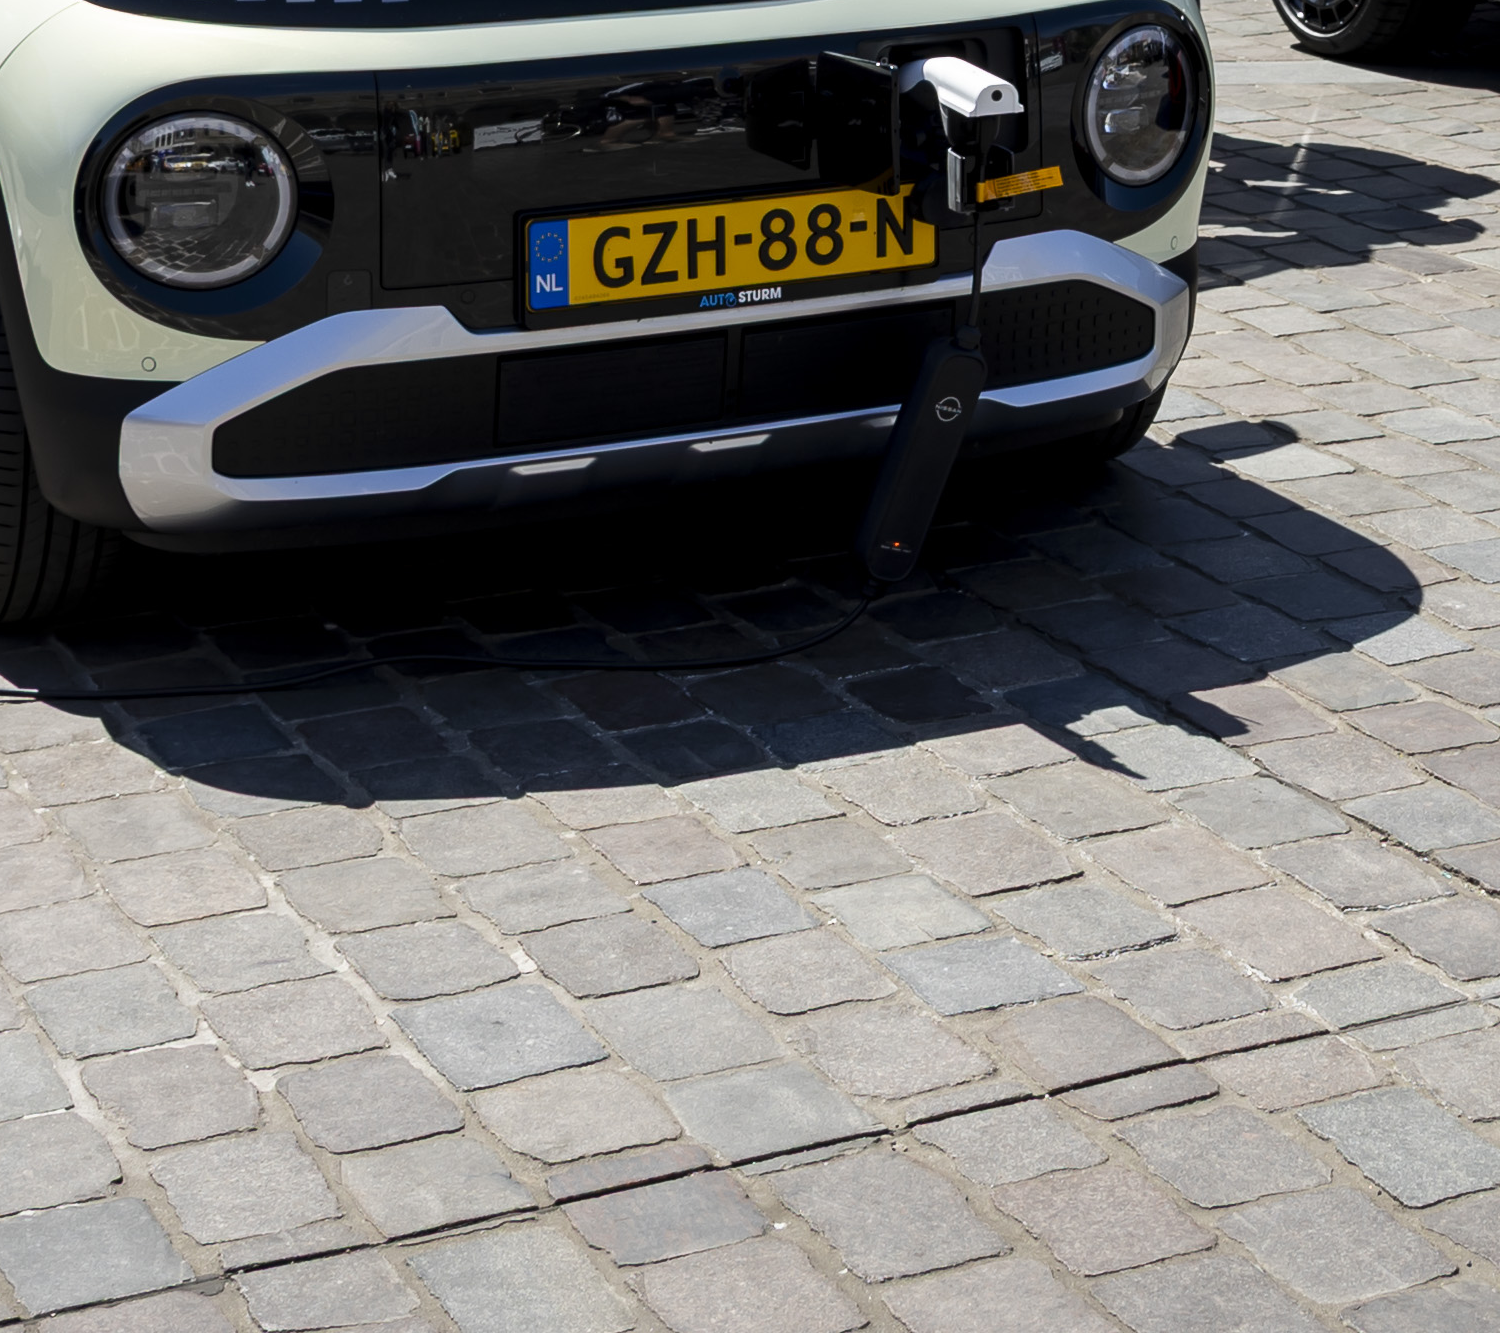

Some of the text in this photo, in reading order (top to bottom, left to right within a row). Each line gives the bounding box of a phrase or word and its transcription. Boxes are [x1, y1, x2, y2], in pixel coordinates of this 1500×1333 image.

[535, 194, 916, 294] NL GZH-88-N
[738, 286, 782, 304] STURM
